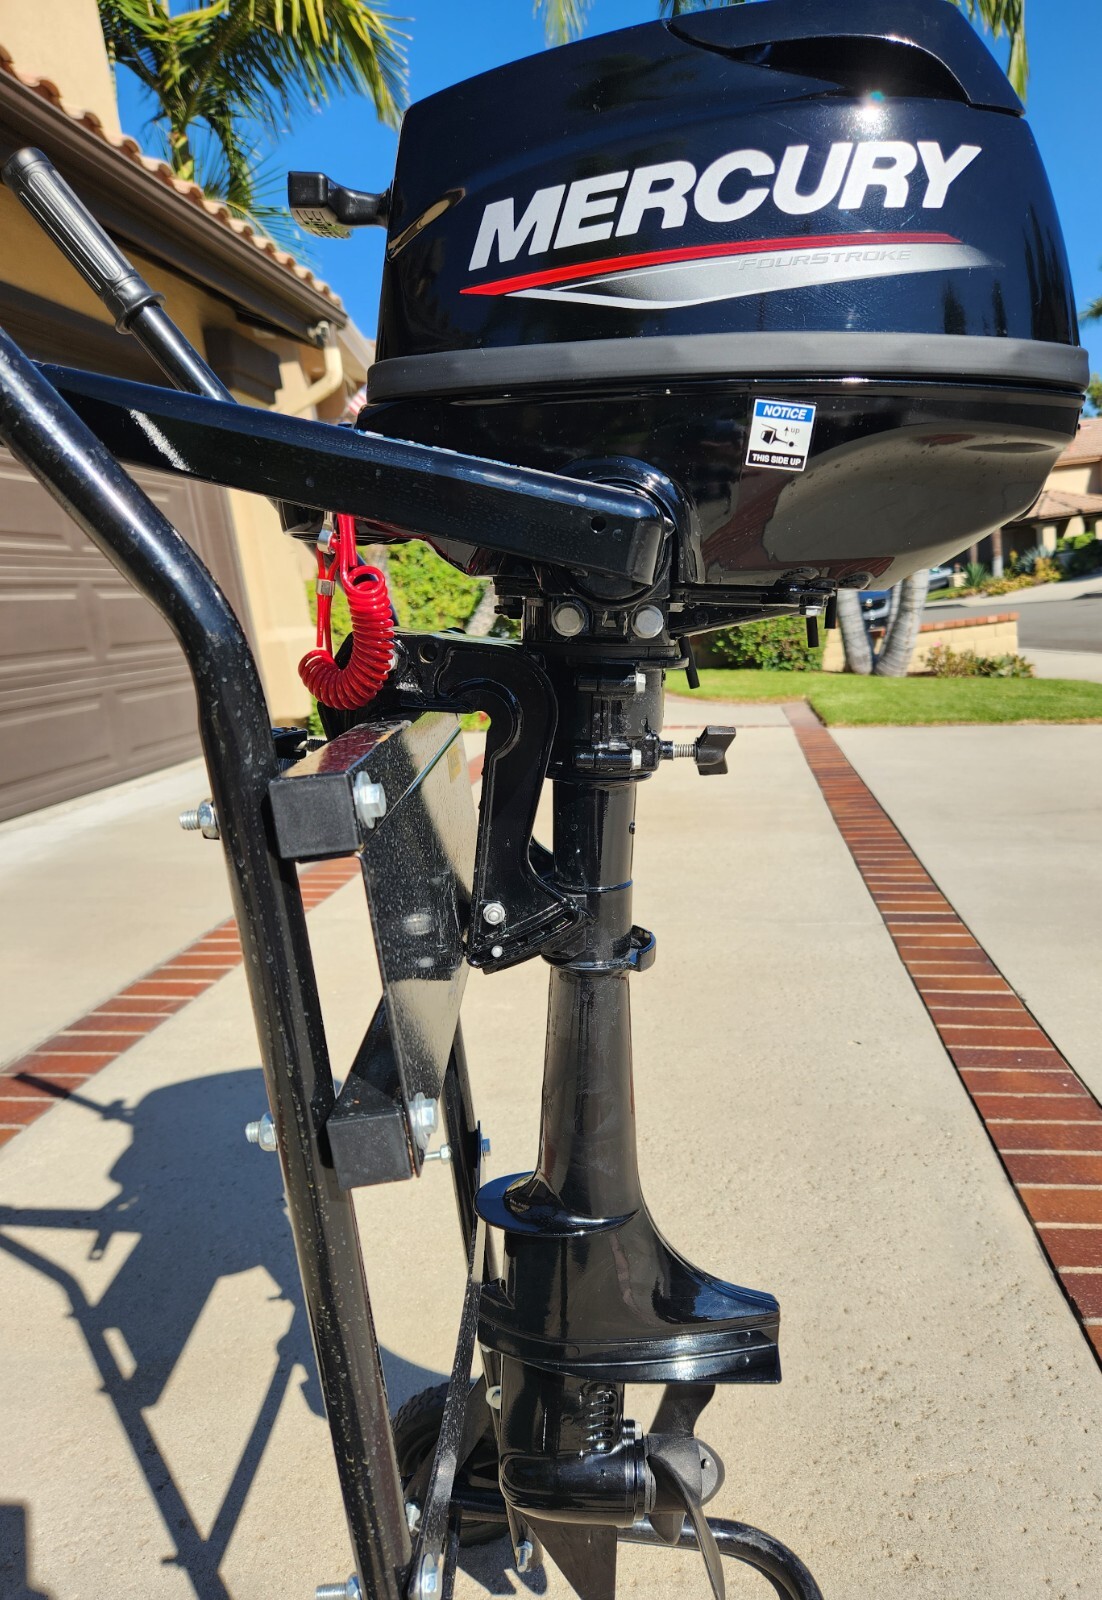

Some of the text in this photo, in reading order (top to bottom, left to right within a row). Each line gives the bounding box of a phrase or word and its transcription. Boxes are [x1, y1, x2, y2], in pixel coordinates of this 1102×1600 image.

[469, 141, 982, 271] MERCURY
[763, 405, 807, 420] NOTICE
[752, 453, 801, 466] THIS SIDE UP
